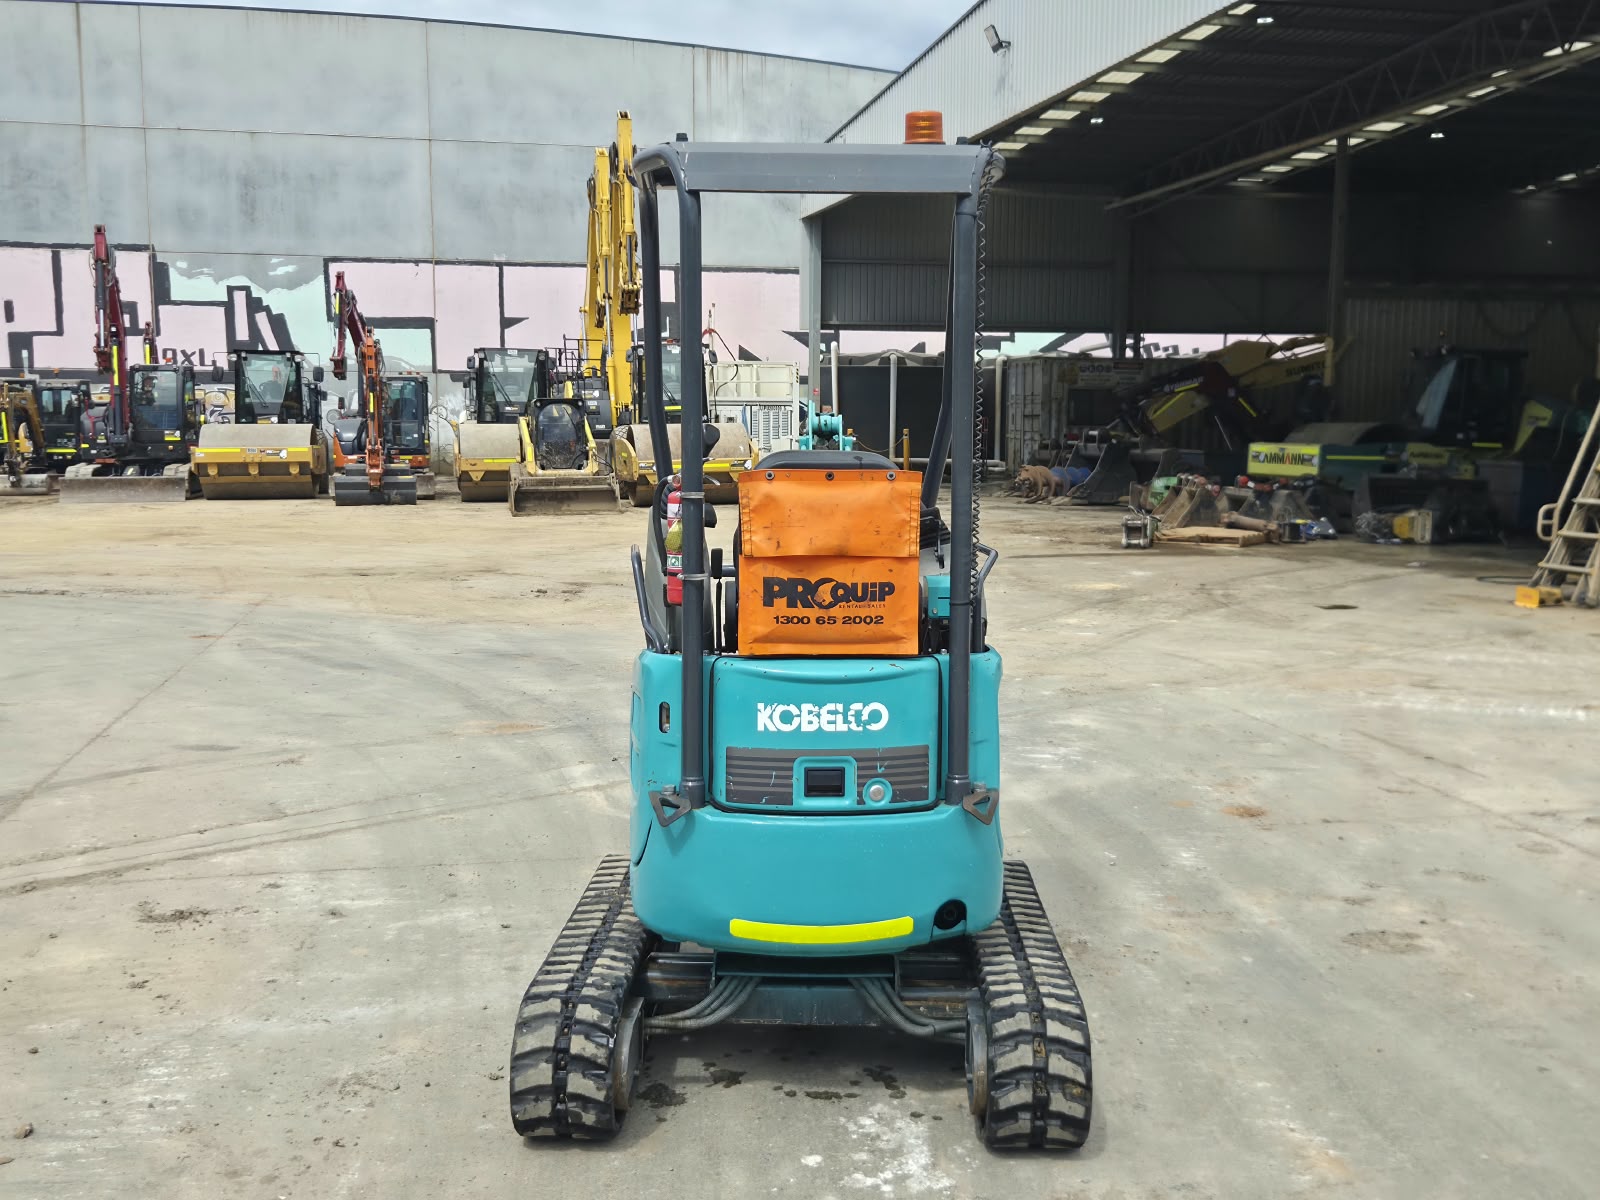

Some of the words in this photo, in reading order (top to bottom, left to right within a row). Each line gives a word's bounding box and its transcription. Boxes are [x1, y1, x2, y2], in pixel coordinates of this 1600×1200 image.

[1262, 451, 1304, 466] AMMANN
[773, 615, 811, 625] 1300
[815, 615, 837, 625] 65
[841, 615, 885, 626] 2002
[757, 701, 890, 732] KOBELCO
